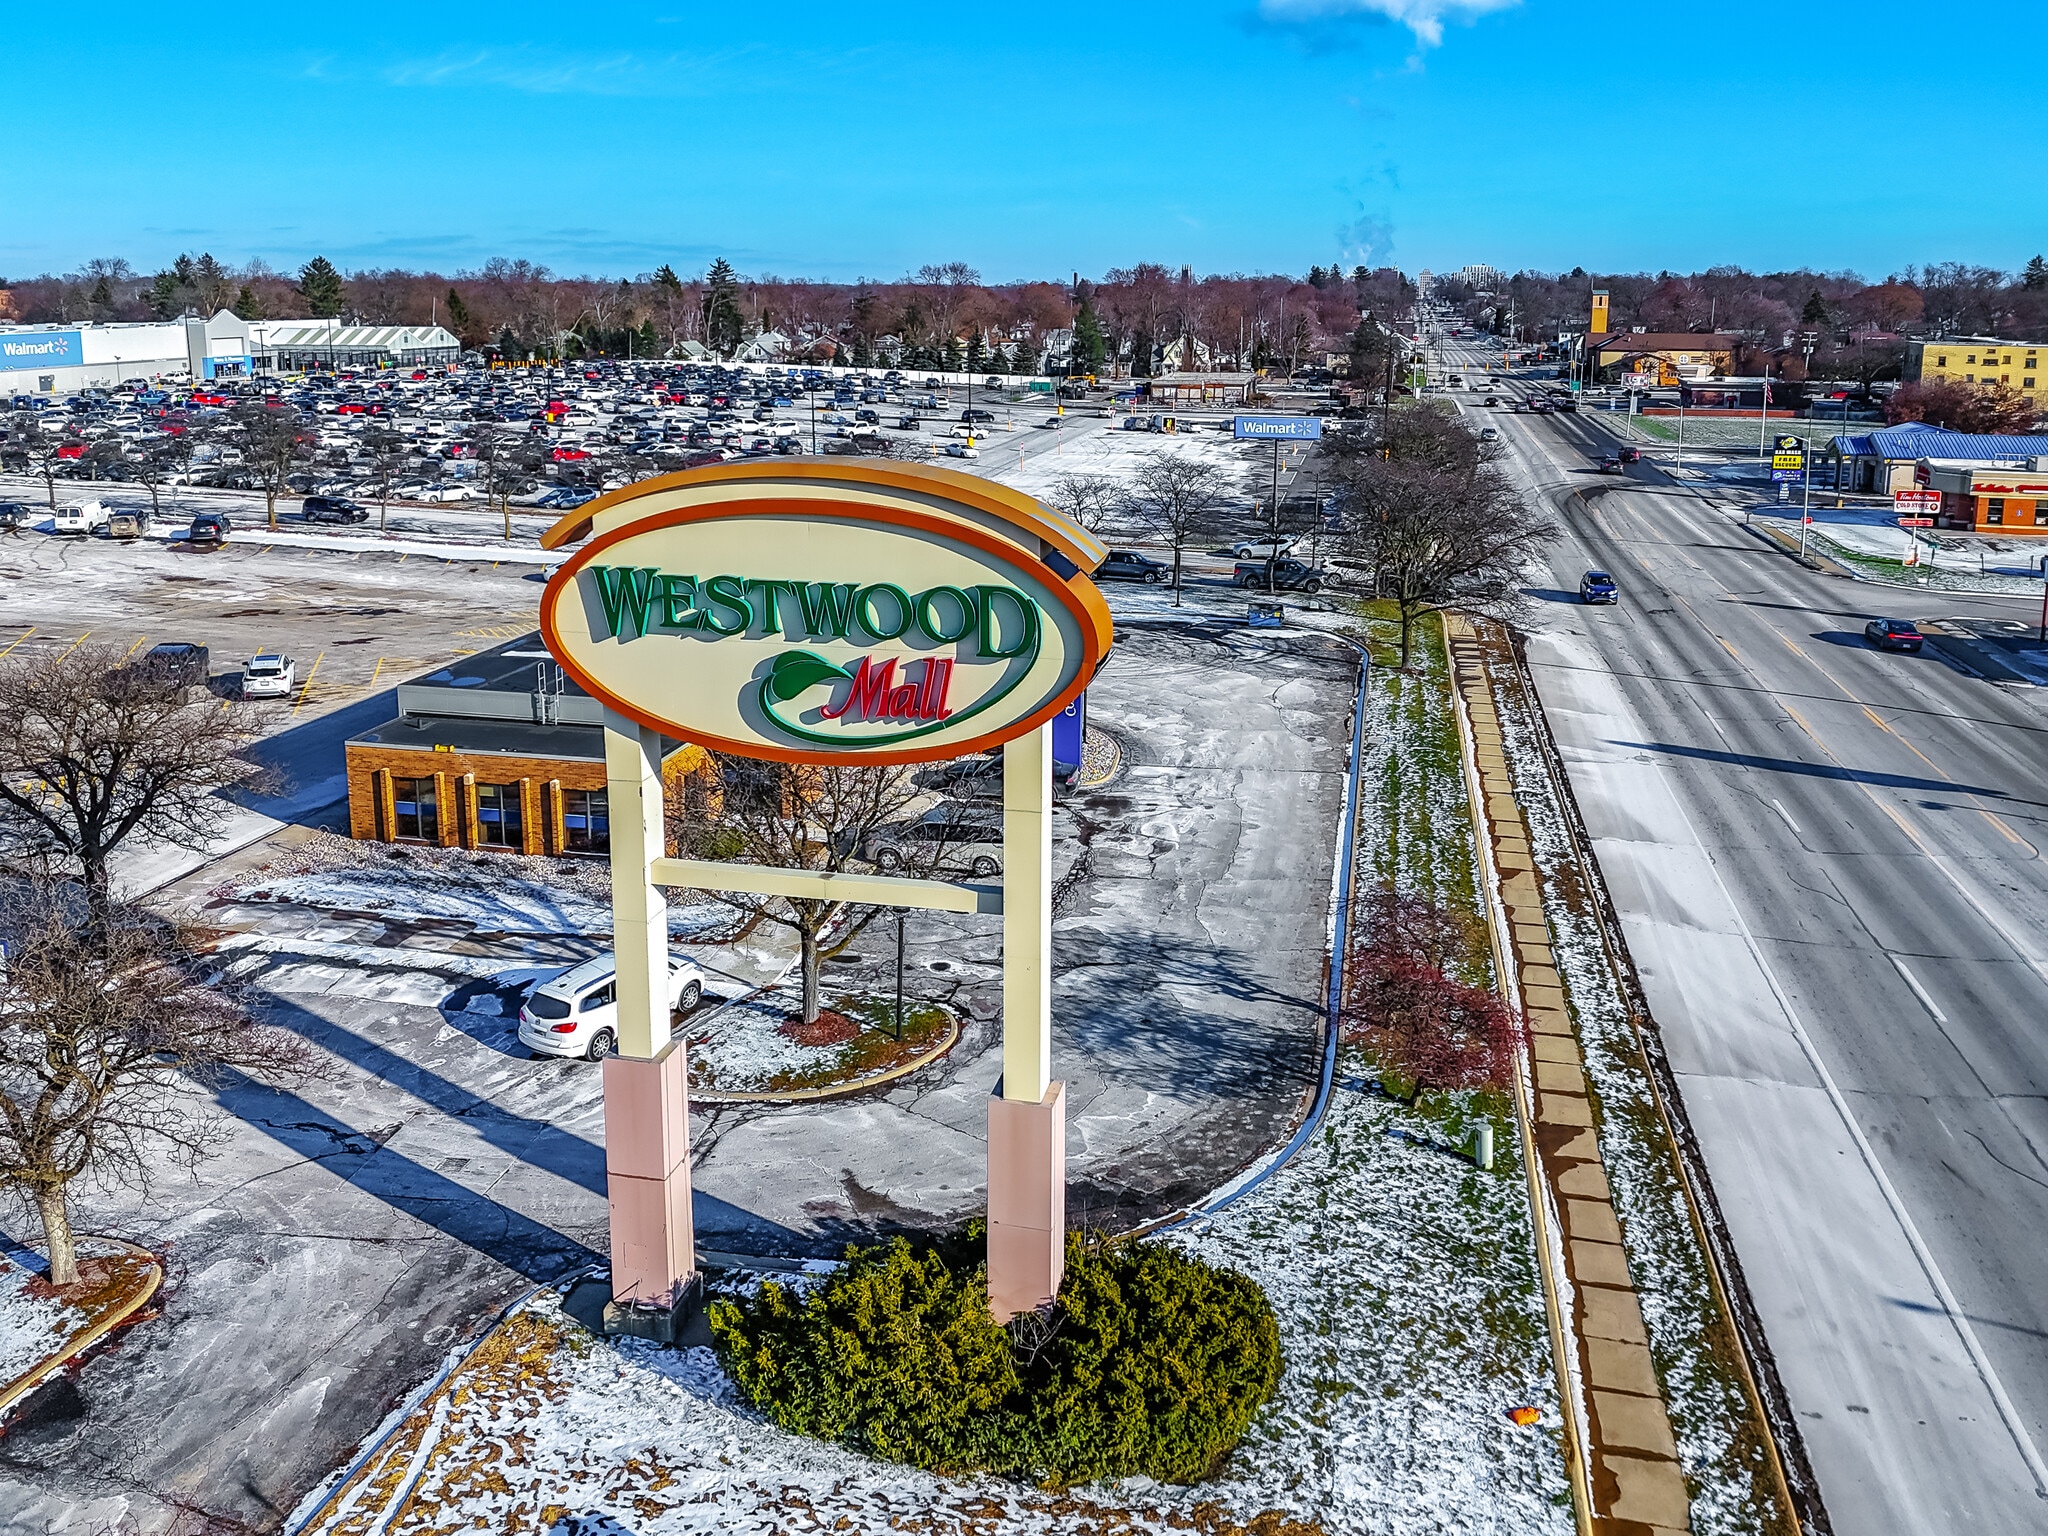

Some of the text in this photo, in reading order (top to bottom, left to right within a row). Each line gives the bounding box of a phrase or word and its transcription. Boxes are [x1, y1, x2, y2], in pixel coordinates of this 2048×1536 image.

[3, 341, 55, 356] Walmart
[1243, 421, 1296, 434] Walmart
[1900, 492, 1911, 500] Tim
[589, 565, 1039, 659] WESTWOOD
[819, 653, 955, 721] Mall
